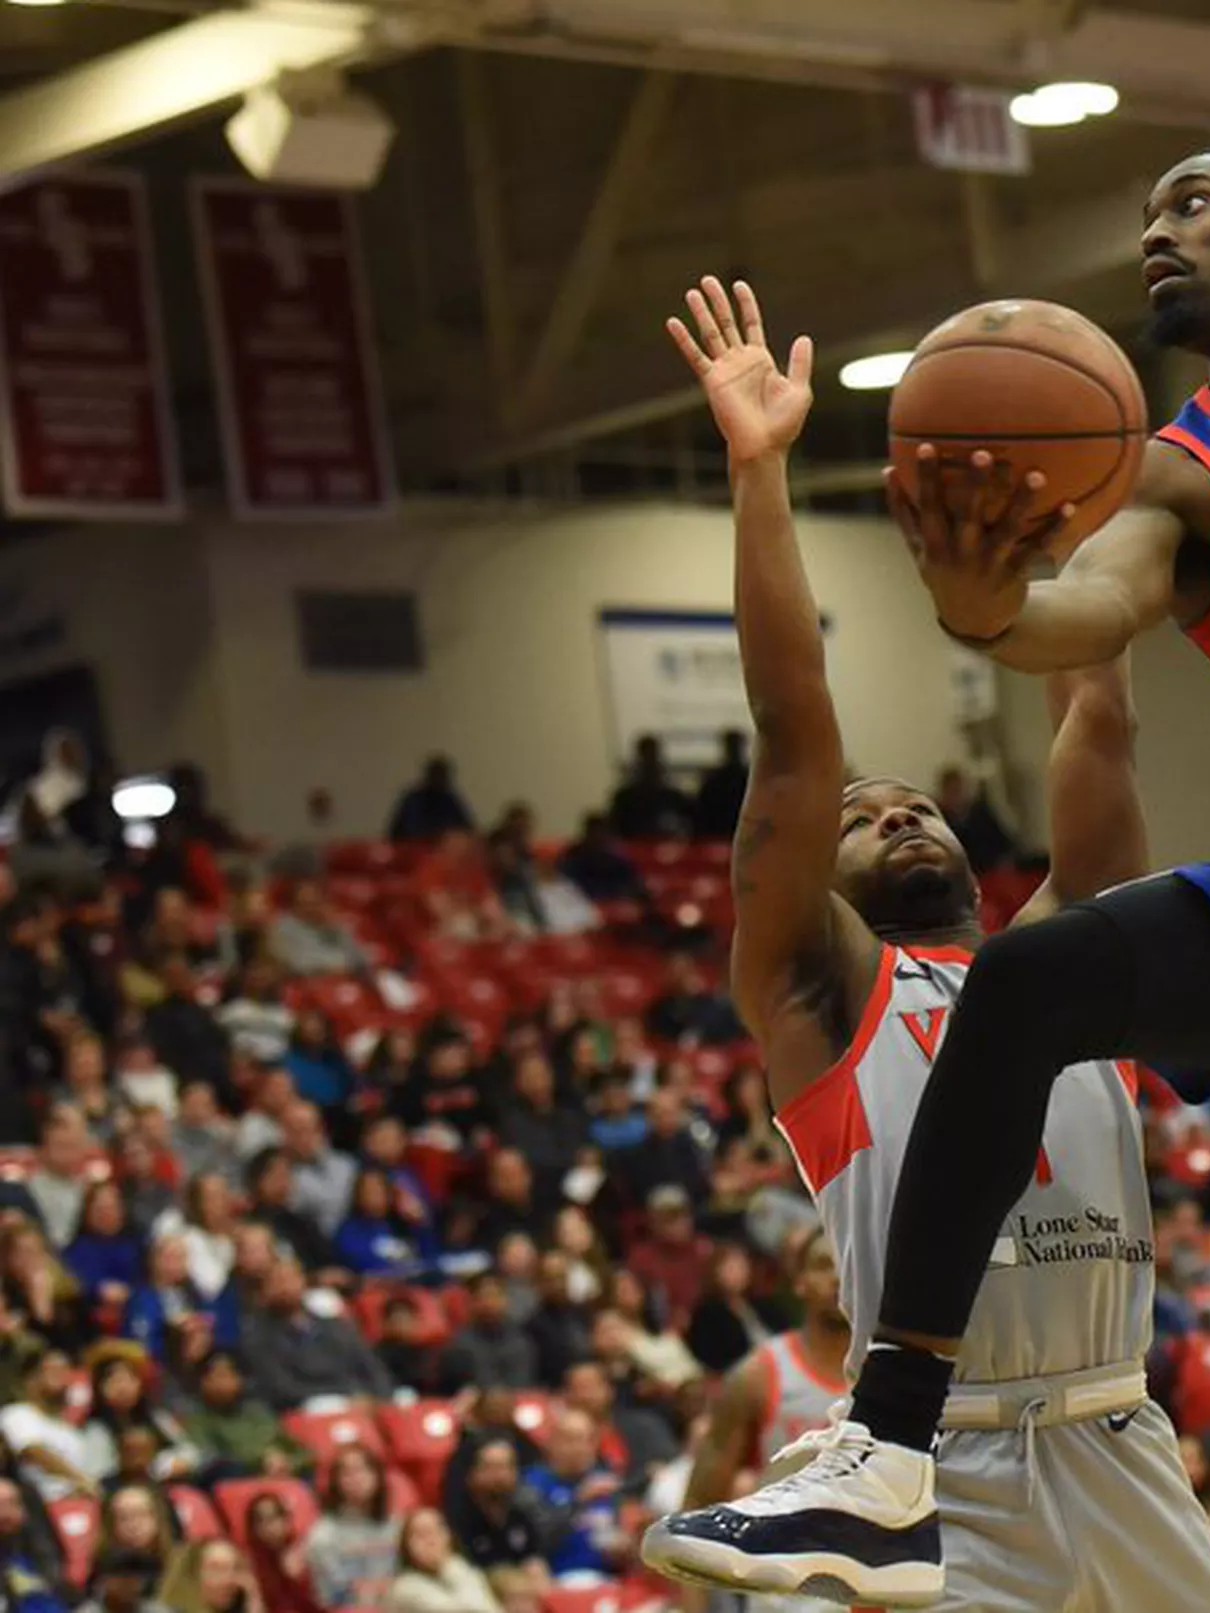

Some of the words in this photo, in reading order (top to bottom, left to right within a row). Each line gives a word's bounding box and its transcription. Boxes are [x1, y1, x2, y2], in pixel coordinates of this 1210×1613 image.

[1018, 1213, 1079, 1239] Lone
[1084, 1205, 1120, 1233] Star
[1018, 1236, 1113, 1267] National
[1114, 1236, 1154, 1264] Bnk
